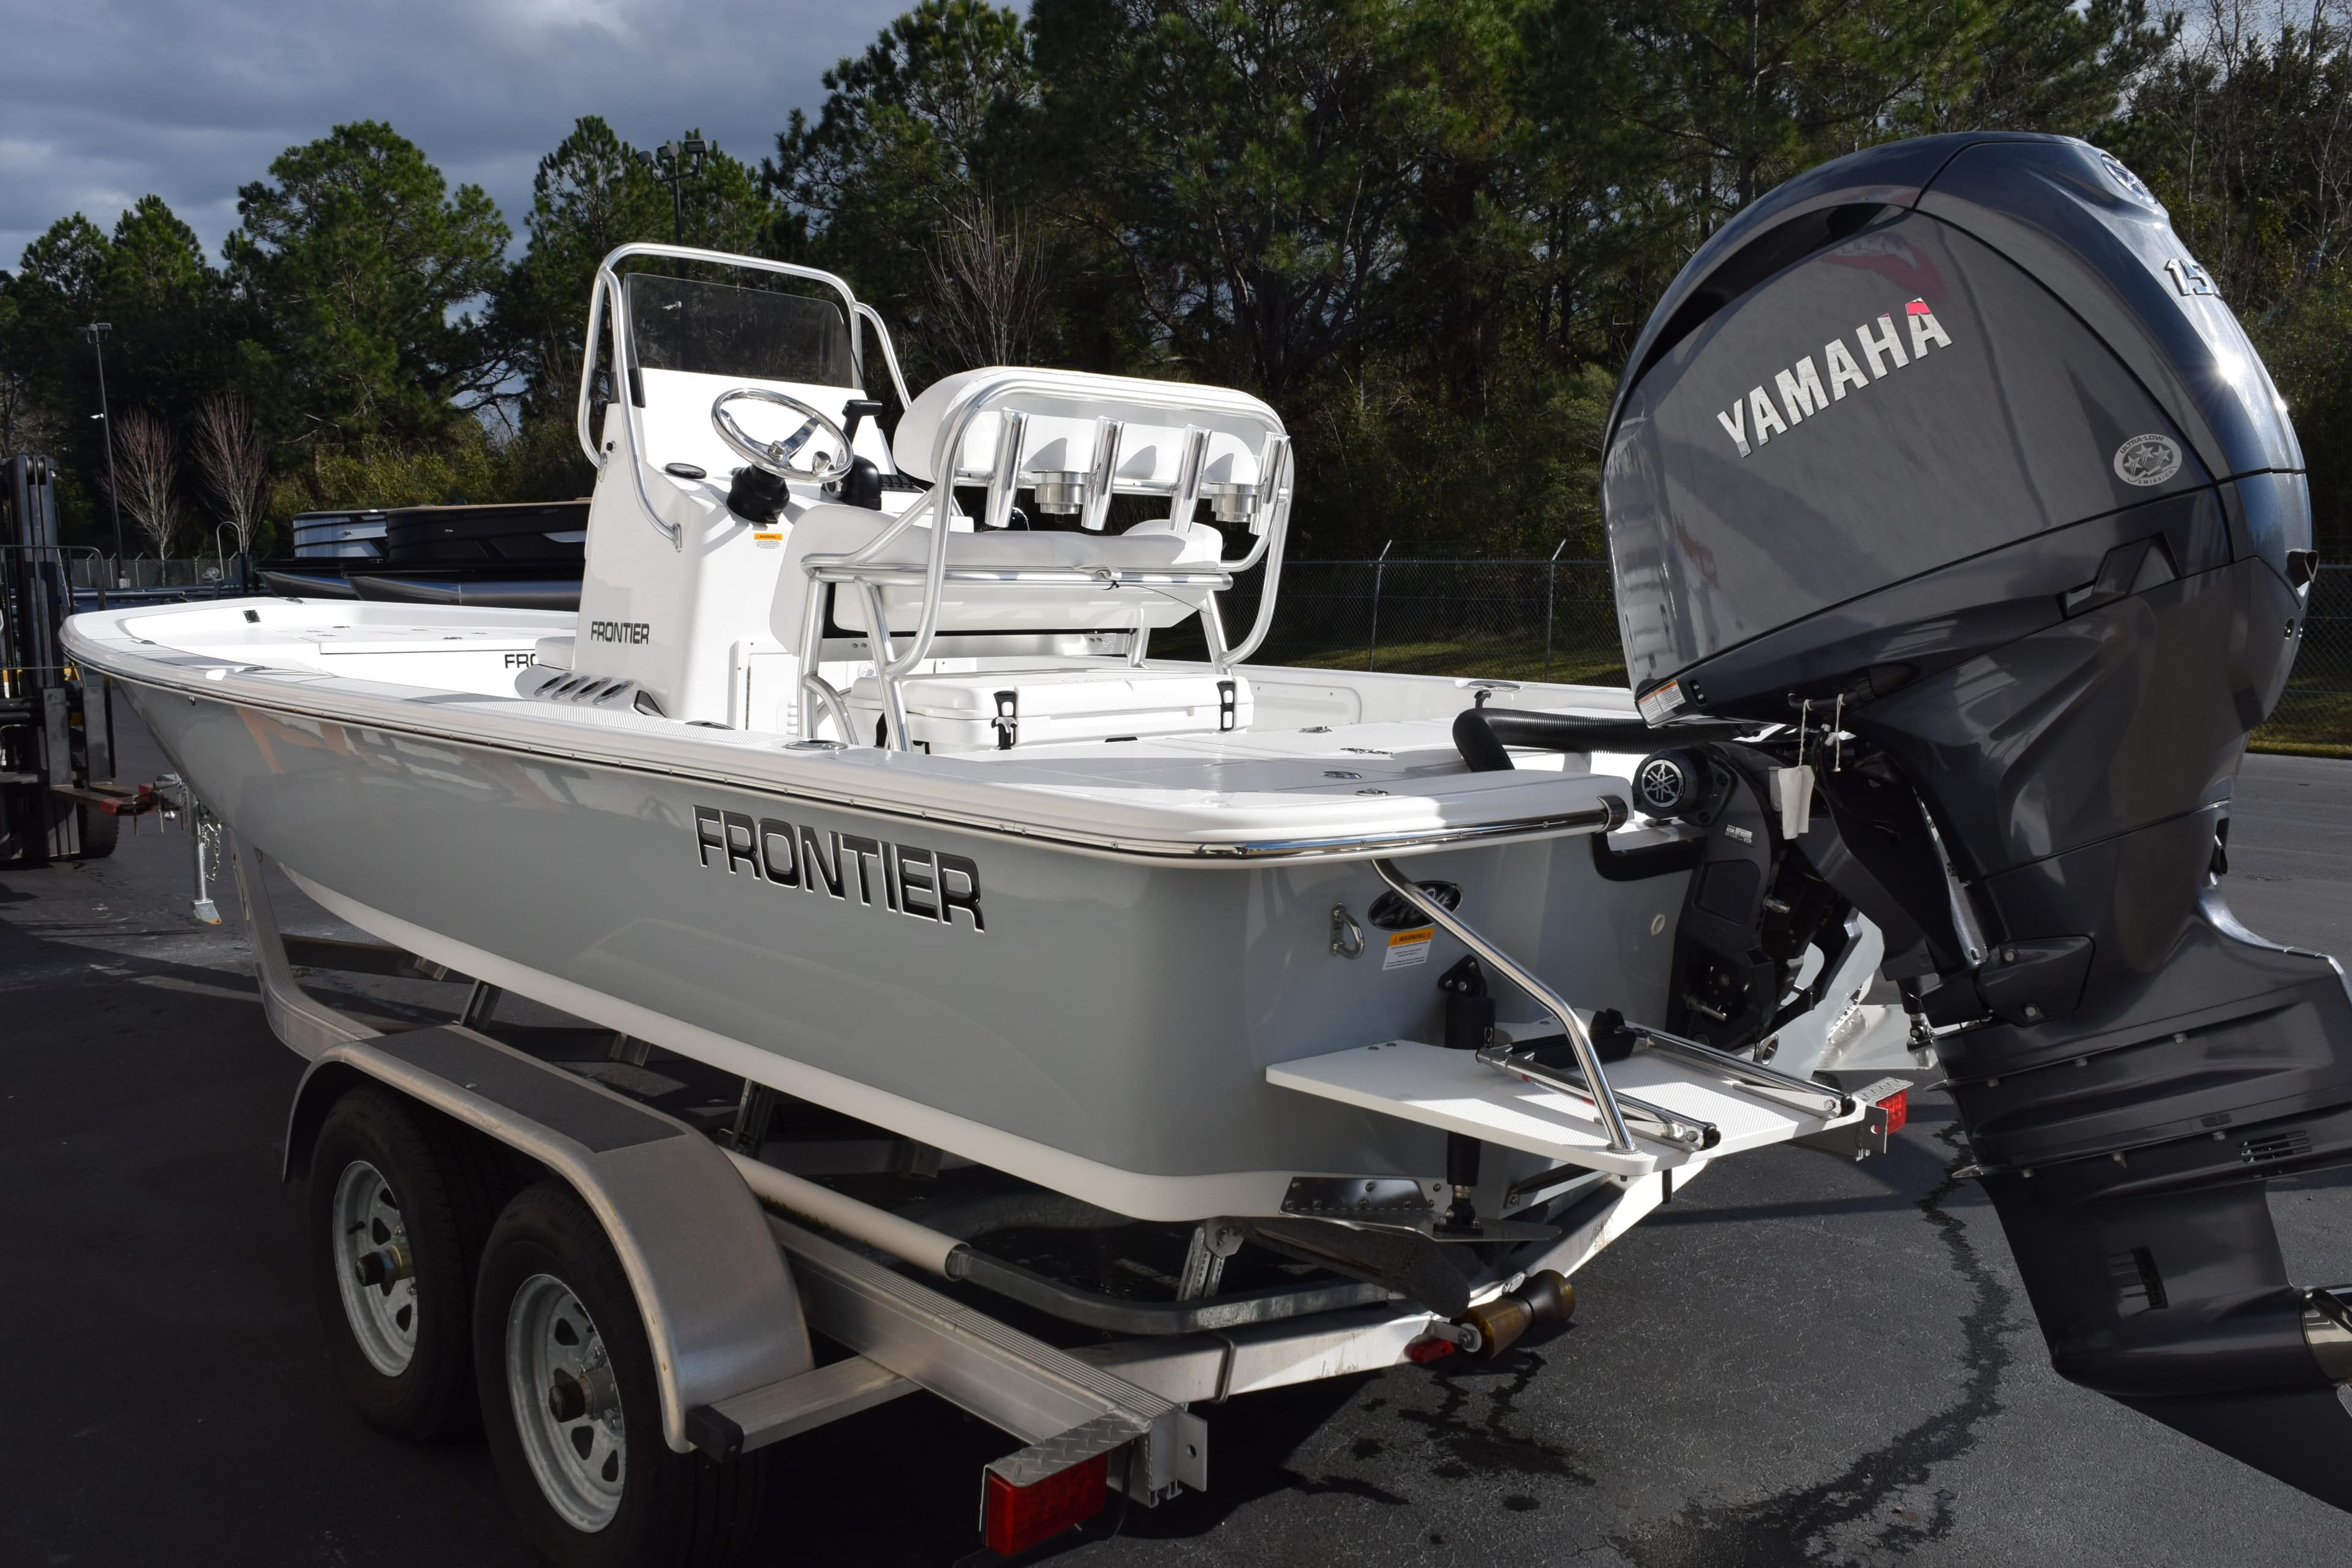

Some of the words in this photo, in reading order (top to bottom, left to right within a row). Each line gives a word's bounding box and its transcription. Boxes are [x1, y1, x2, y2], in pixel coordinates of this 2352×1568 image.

[1716, 296, 1953, 458] YAMAHA
[2138, 469, 2174, 484] EMISSION
[590, 620, 650, 645] FRONTIER
[692, 804, 986, 934] FRONTIER
[1399, 932, 1426, 942] WARNING
